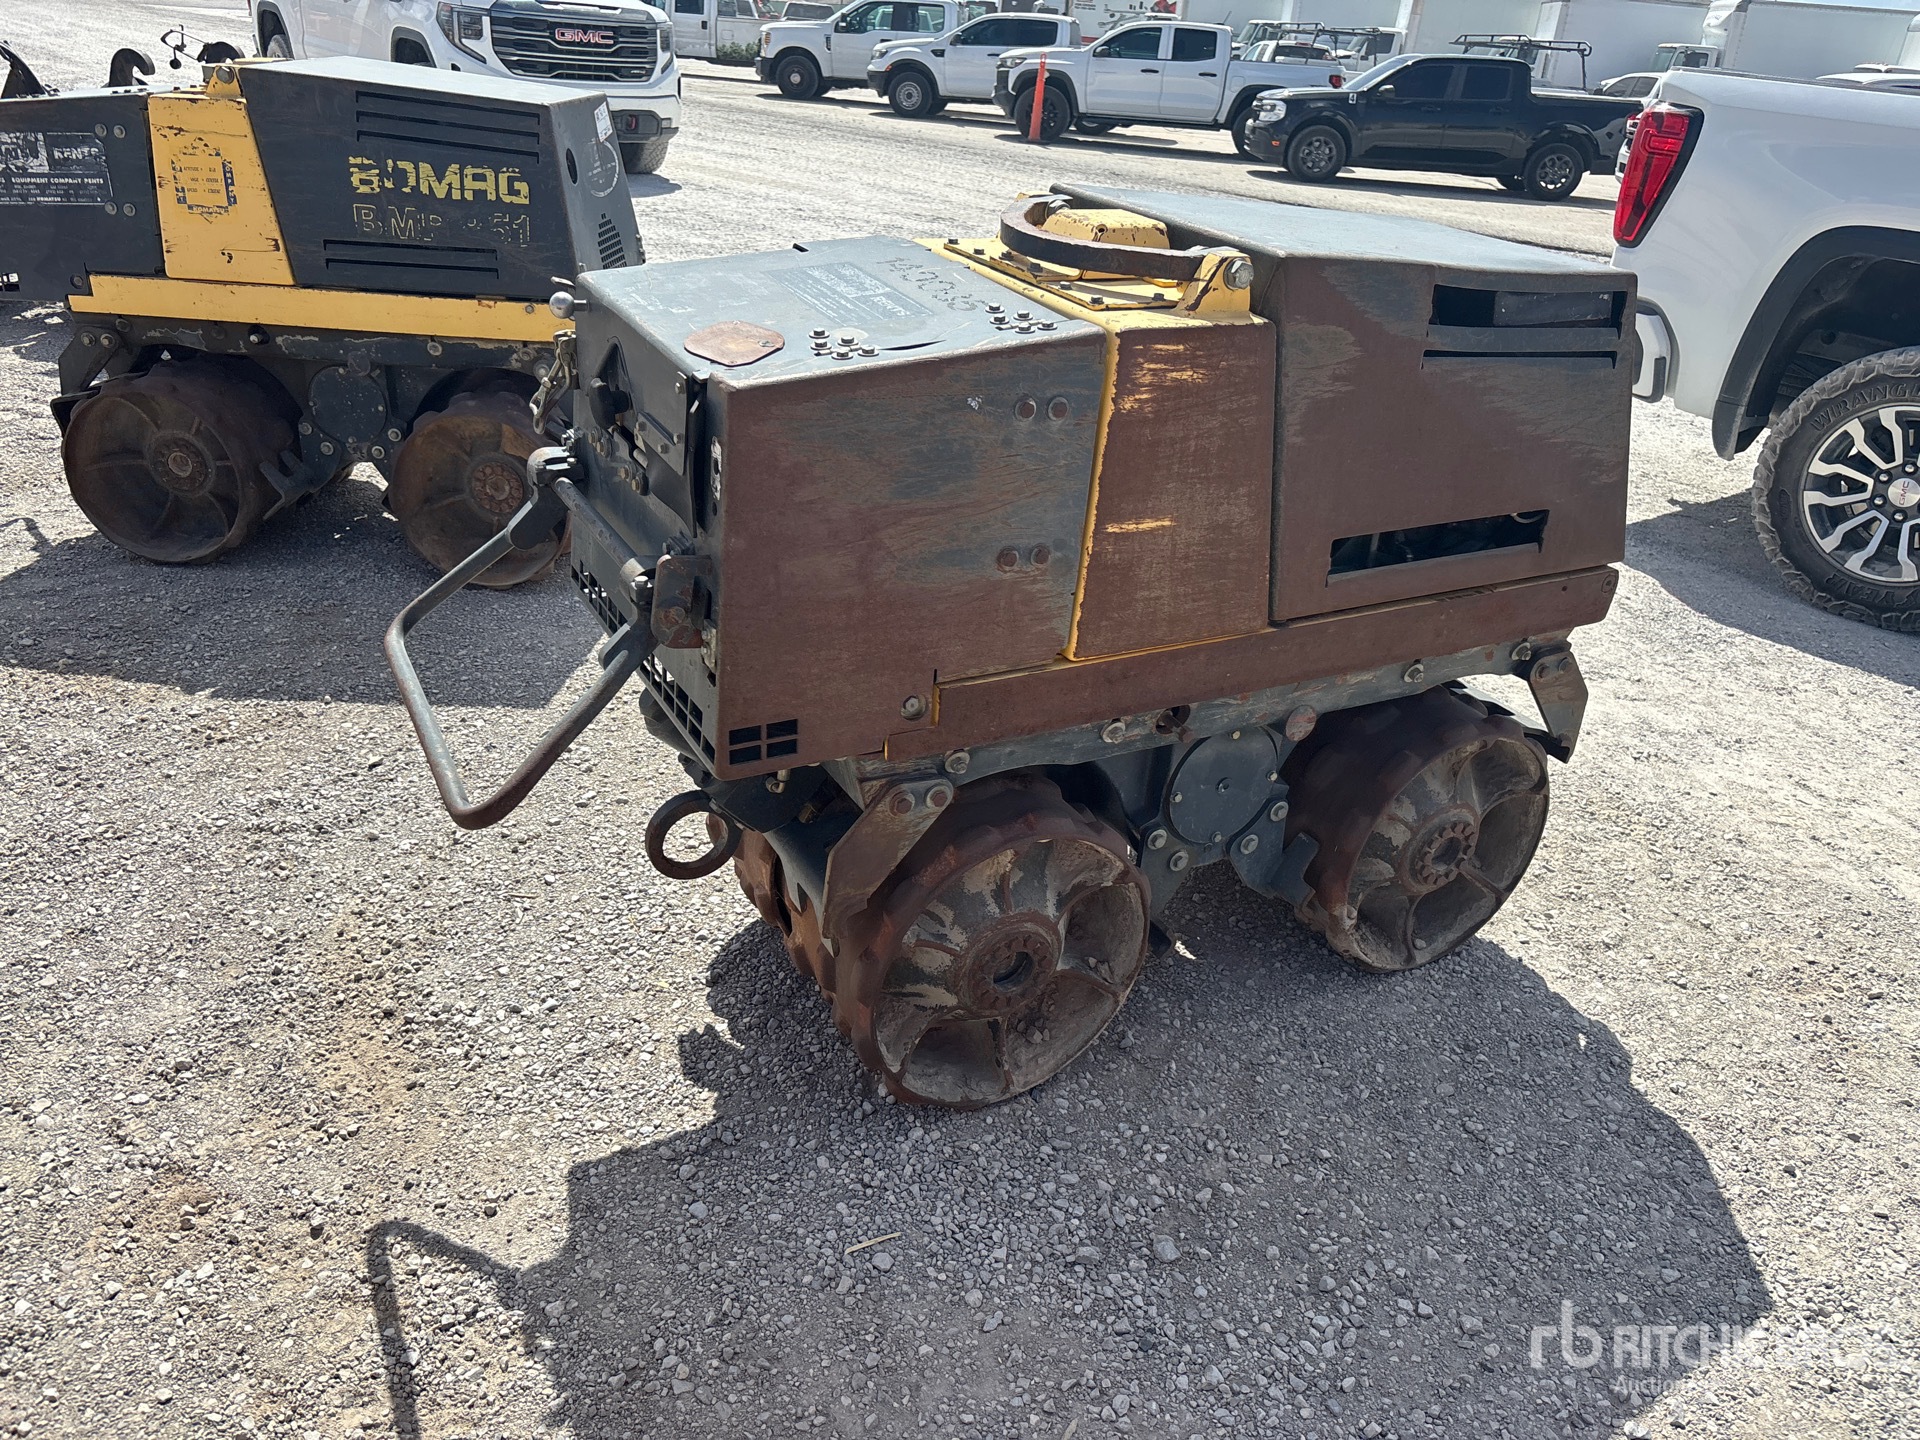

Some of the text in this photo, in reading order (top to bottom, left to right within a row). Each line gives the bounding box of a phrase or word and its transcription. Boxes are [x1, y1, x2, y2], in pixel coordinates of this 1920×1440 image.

[555, 27, 614, 44] GMC
[348, 155, 530, 205] BOMAG
[1898, 480, 1910, 506] GMC
